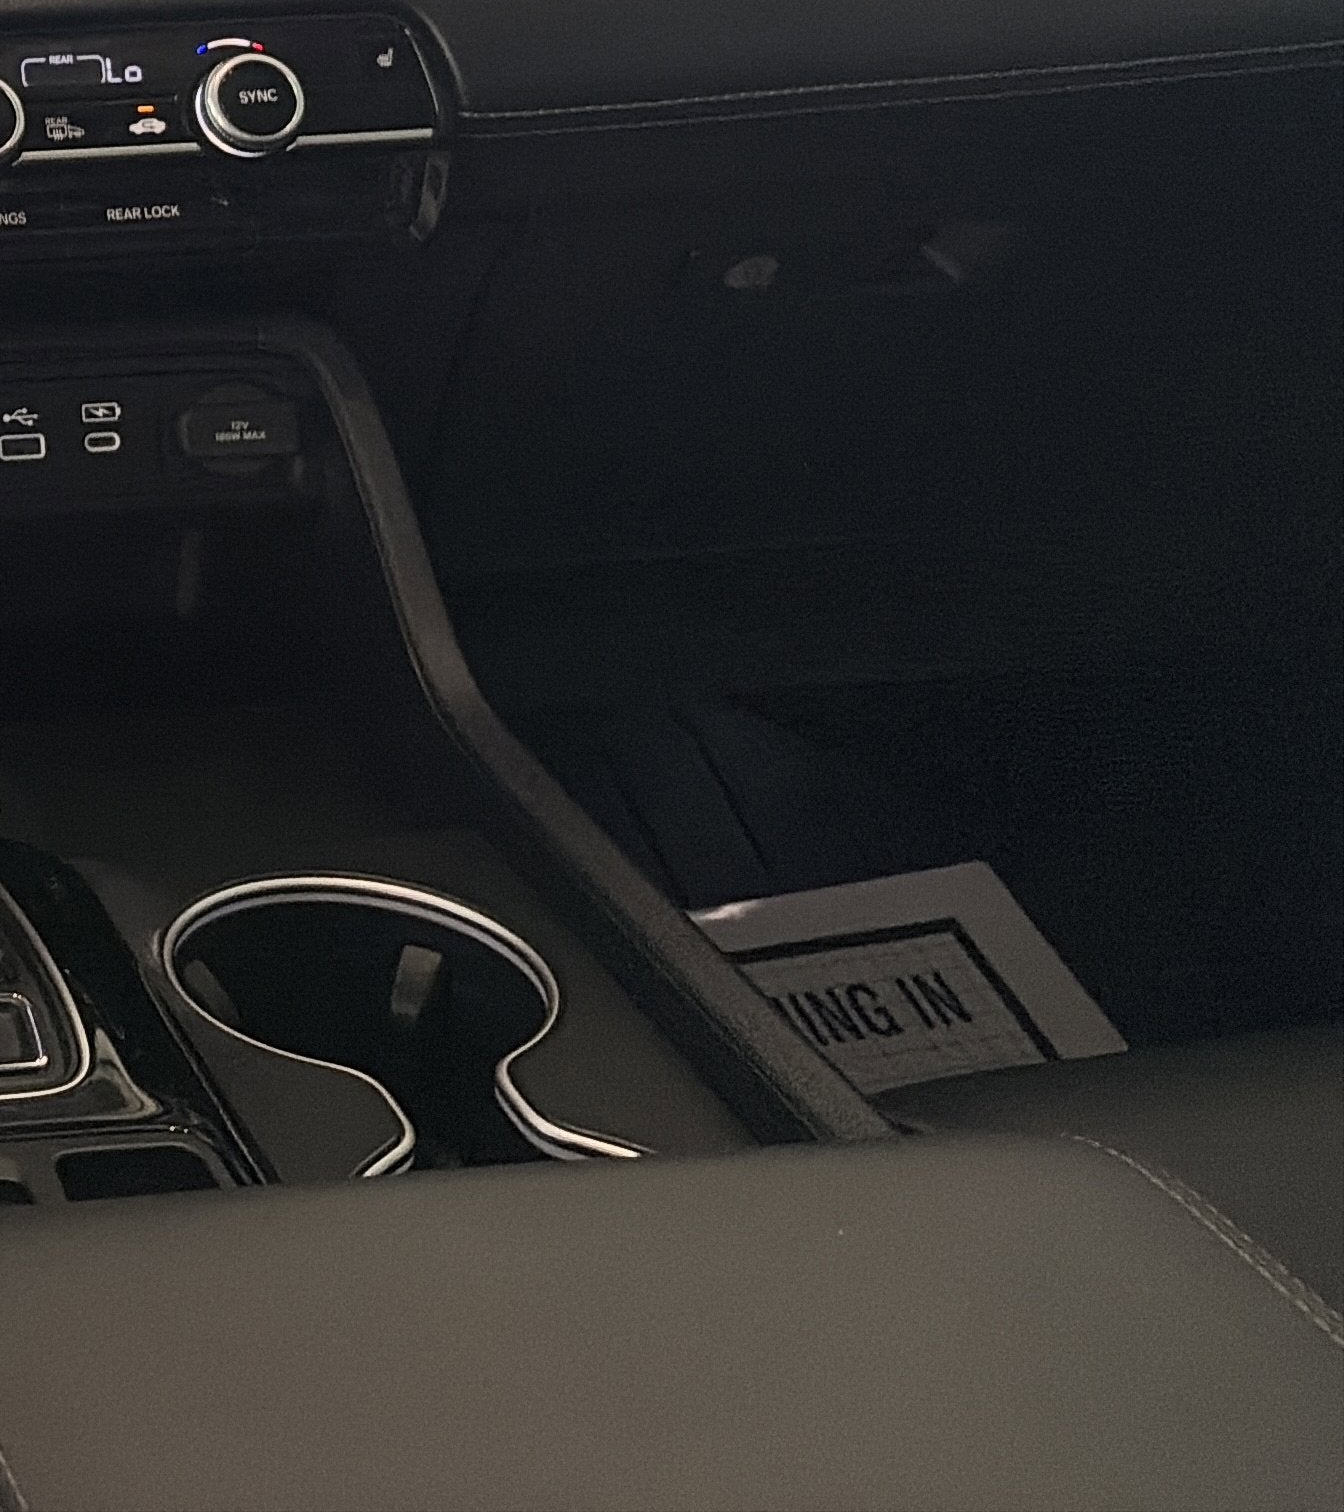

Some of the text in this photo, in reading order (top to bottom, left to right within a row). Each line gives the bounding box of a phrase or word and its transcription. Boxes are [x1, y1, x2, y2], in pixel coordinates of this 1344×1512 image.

[48, 54, 74, 65] REAR
[105, 57, 143, 85] Lo
[239, 88, 279, 105] SYNC
[45, 116, 68, 126] REAR
[106, 204, 181, 222] REAR LOCK
[774, 970, 973, 1046] ING IN
